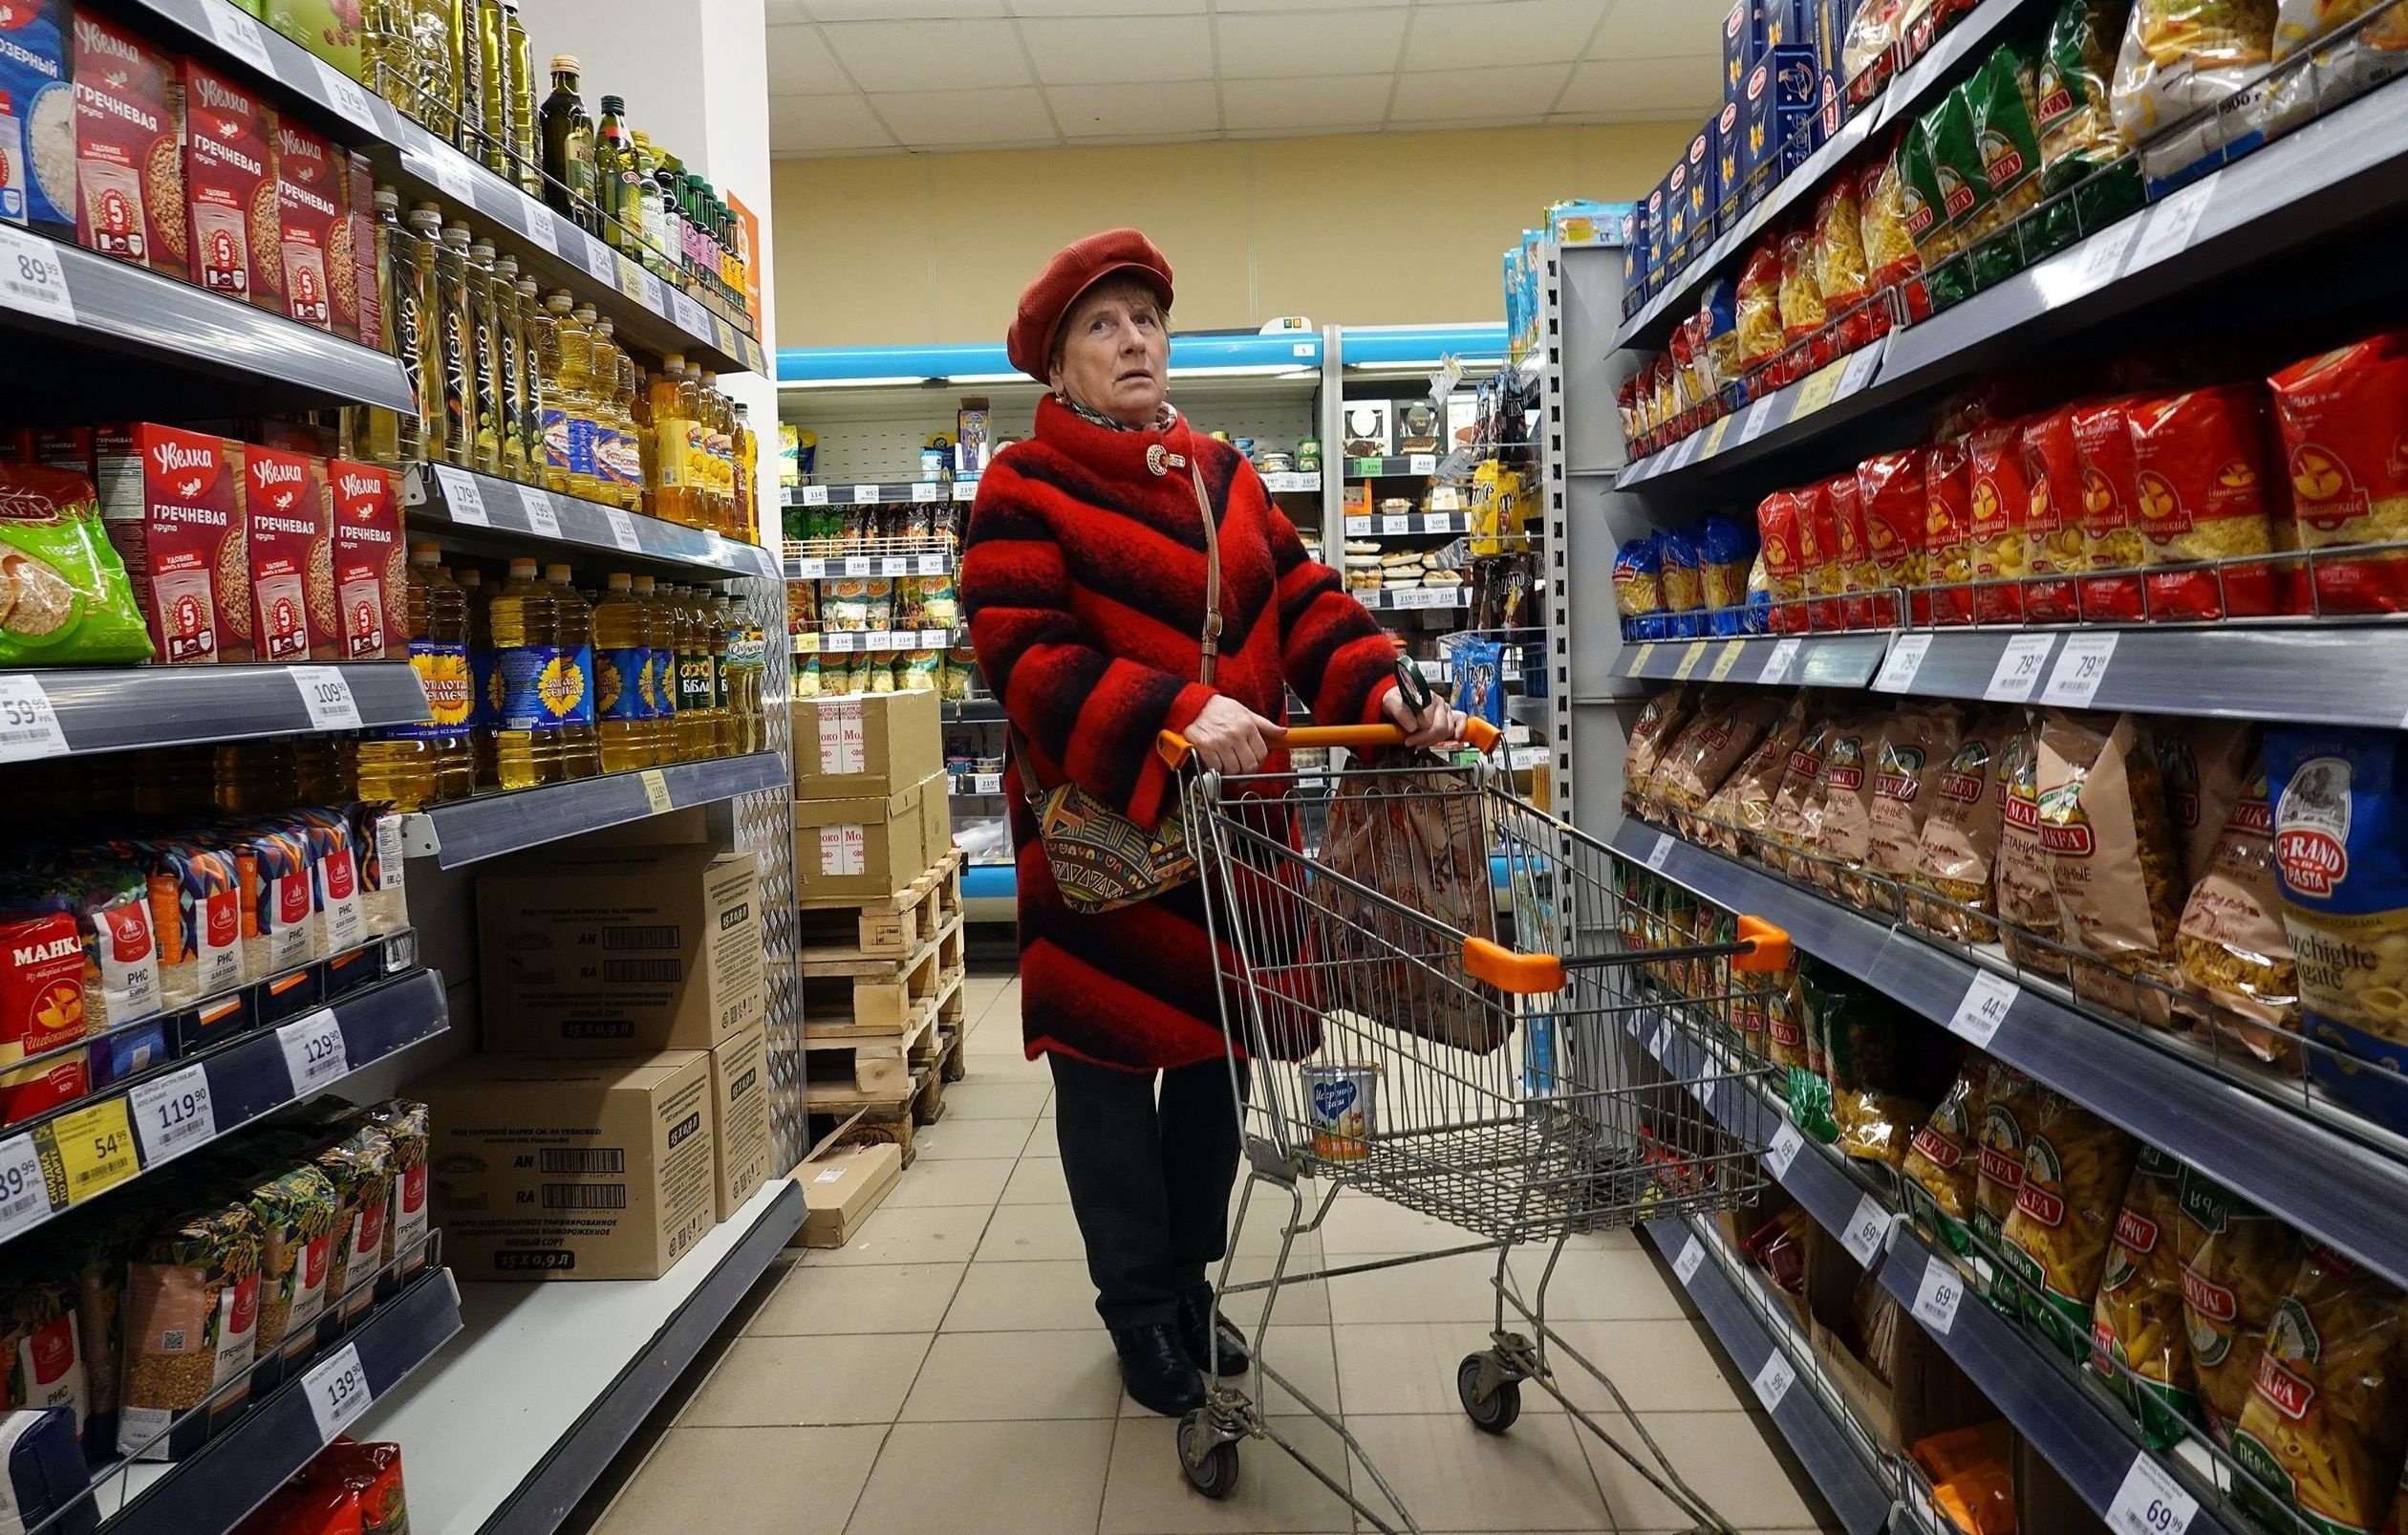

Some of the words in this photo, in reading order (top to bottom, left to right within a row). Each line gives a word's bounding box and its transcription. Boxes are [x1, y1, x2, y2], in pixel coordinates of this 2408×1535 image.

[75, 21, 140, 64] Увелка
[76, 82, 158, 132] ГРЕЧНЕВАЯ
[195, 78, 249, 117] Увелка
[194, 134, 262, 177] ГРЕЧНЕВАЯ
[277, 128, 322, 161] Увелка
[279, 180, 334, 216] ГРЕЧНЕВАЯ
[109, 199, 123, 224] 5
[217, 239, 230, 262] 5
[17, 254, 47, 284] 89
[301, 275, 312, 296] 5
[401, 297, 420, 384] Altero
[447, 312, 463, 395] Altero
[477, 324, 493, 406] Altero
[503, 337, 519, 415] Altero
[528, 349, 543, 423] Altero
[153, 442, 213, 475] Увелка
[252, 459, 303, 488] Увелка
[340, 473, 381, 500] Увелка
[453, 485, 475, 504] 179
[153, 504, 227, 527] ГРЕЧНЕВАЯ
[531, 501, 549, 517] 199
[153, 523, 178, 533] крупа
[254, 516, 315, 535] ГРЕЧНЕВАЯ
[255, 533, 275, 542] крупа
[340, 526, 392, 543] ГРЕЧНЕВАЯ
[182, 606, 195, 627] 5
[279, 606, 290, 626] 5
[358, 606, 369, 625] 5
[2014, 655, 2033, 675] 79
[2075, 656, 2097, 678] 79
[314, 683, 341, 703] 109
[3, 699, 35, 725] 59
[2278, 835, 2340, 872] GRAND
[2287, 865, 2325, 890] PASTA
[1982, 997, 1999, 1018] 44
[304, 1035, 333, 1063] 129
[330, 1029, 339, 1041] 90
[159, 1094, 196, 1129] 119
[194, 1088, 206, 1102] 90
[95, 1134, 118, 1159] 54
[21, 1159, 36, 1176] 99
[513, 1155, 534, 1168] AN
[40, 1151, 59, 1204] СКИДКА
[516, 1190, 535, 1203] RA
[1862, 1222, 1877, 1239] 69
[1935, 1285, 1952, 1307] 69
[328, 1371, 355, 1406] 139
[353, 1362, 362, 1375] 90
[2146, 1499, 2172, 1530] 69
[2171, 1515, 2183, 1532] 99
